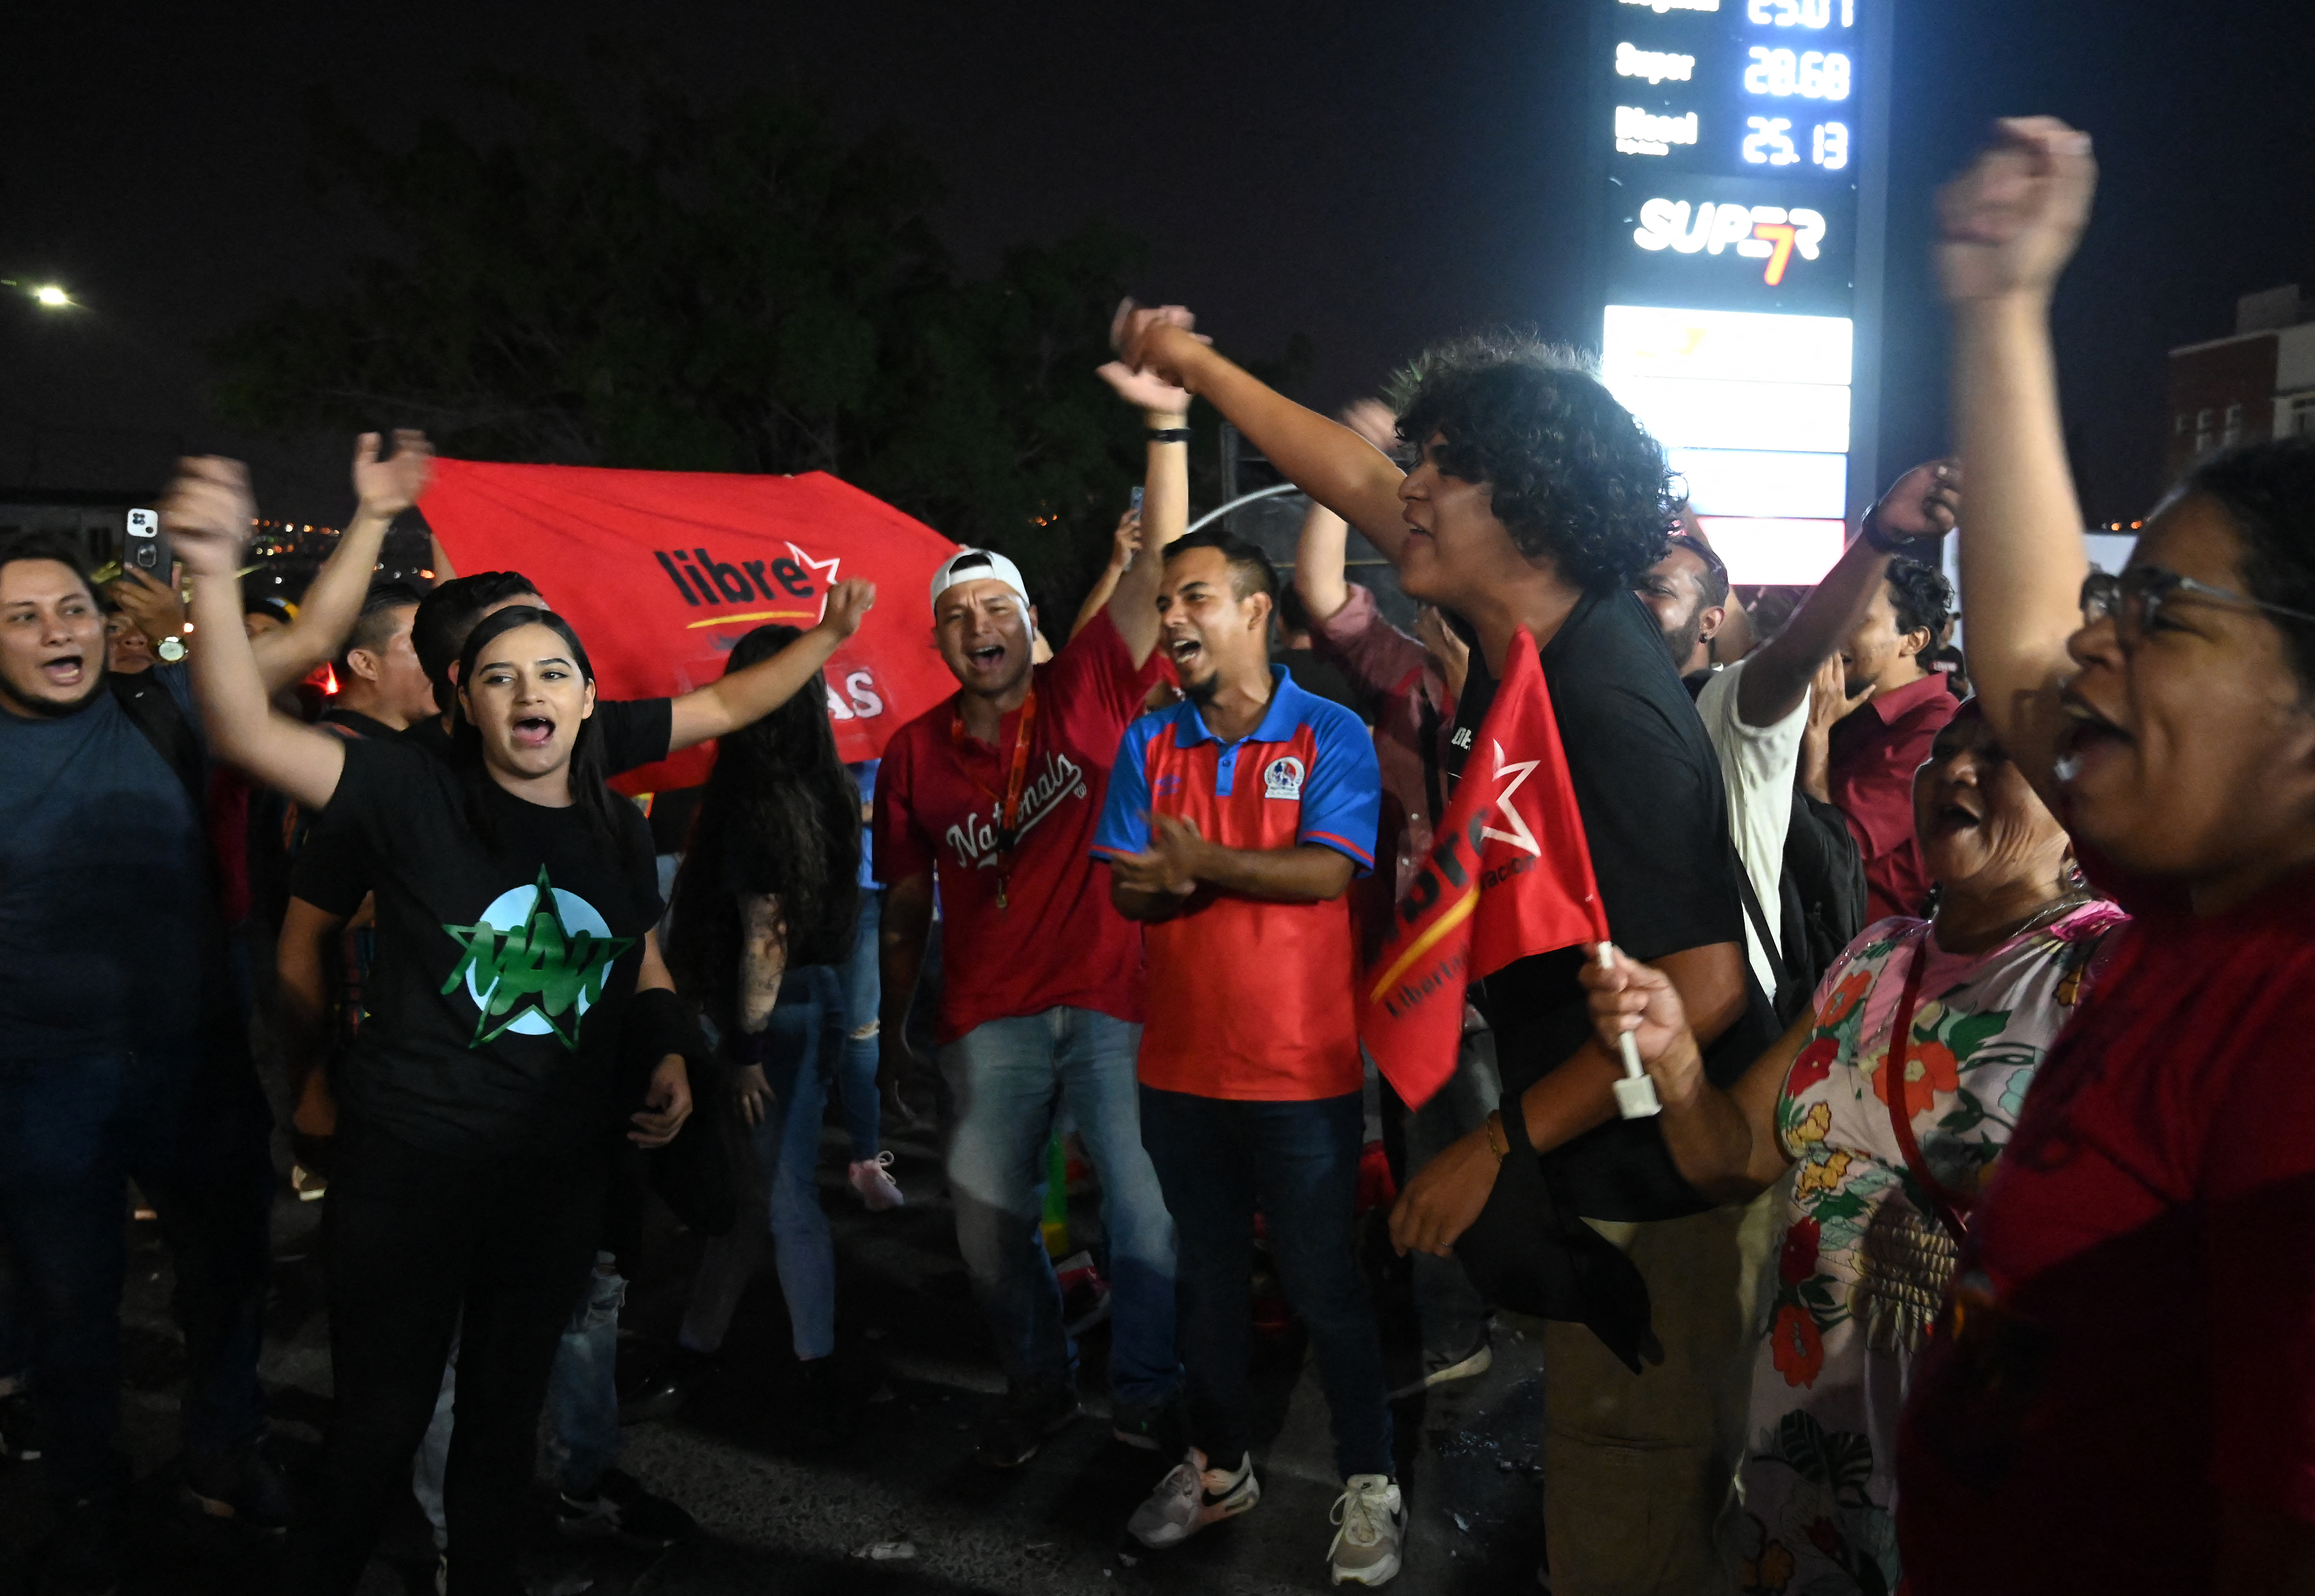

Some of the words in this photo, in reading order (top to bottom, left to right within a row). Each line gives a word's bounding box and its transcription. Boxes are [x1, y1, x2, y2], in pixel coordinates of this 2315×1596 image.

[1745, 47, 1849, 100] 28.68
[1634, 199, 1825, 260] SUPER
[1753, 223, 1796, 286] 7
[655, 548, 815, 606] libre
[946, 751, 1083, 868] Natonals
